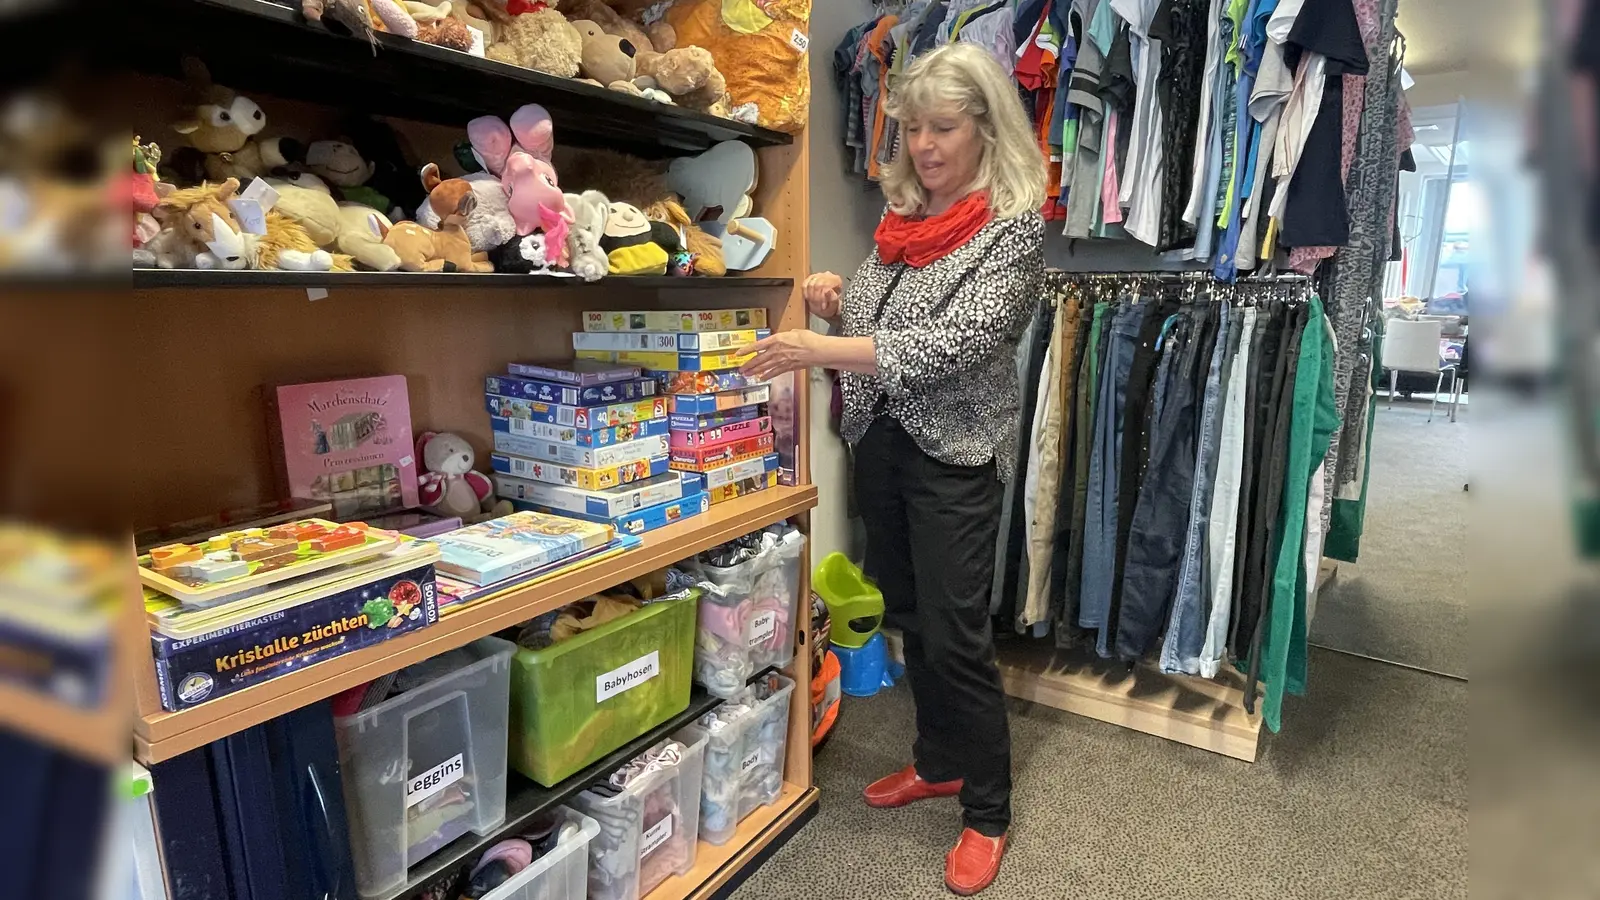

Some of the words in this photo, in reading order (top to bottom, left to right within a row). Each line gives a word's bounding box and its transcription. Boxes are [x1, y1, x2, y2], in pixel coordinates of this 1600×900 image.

[588, 313, 602, 321] 100
[698, 312, 713, 321] 100
[659, 335, 675, 348] 300
[597, 411, 607, 423] 40
[723, 421, 751, 432] PUZZLE
[424, 584, 436, 623] KOSMOS
[171, 611, 285, 651] EXPERIMENTIERKASTEN
[215, 634, 300, 673] Kristalle
[302, 613, 369, 645] züchten
[155, 660, 169, 708] KOSMOS
[604, 663, 653, 692] Babyhosen
[183, 681, 211, 698] KOSMOS
[742, 752, 759, 770] Body
[406, 759, 462, 796] Leggins
